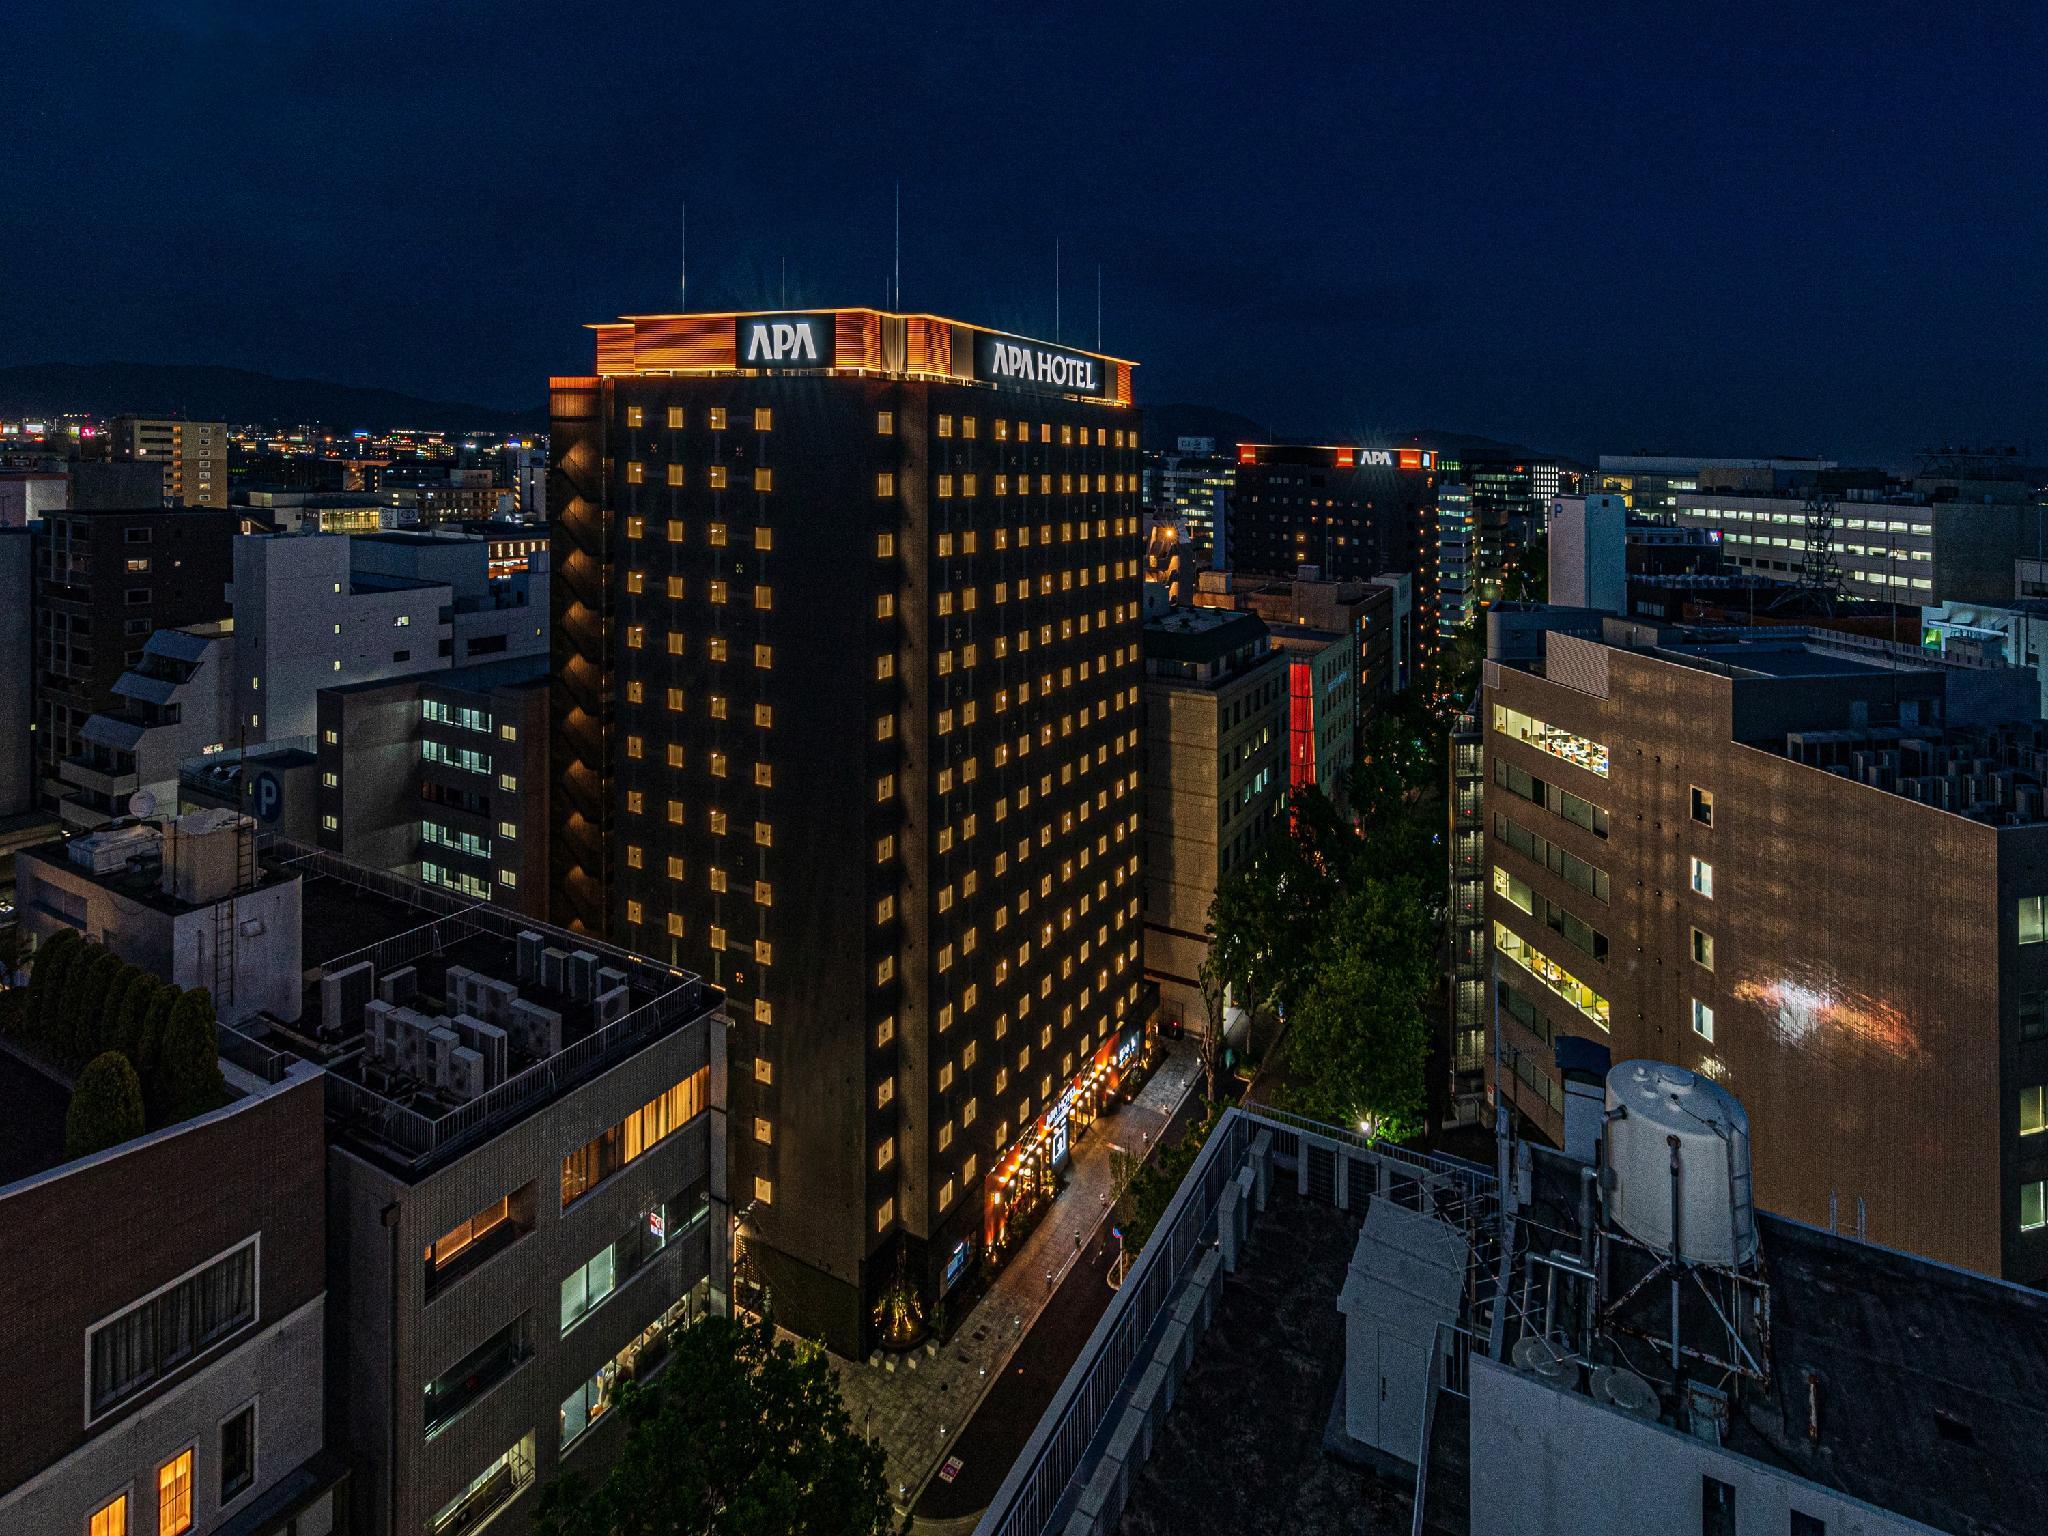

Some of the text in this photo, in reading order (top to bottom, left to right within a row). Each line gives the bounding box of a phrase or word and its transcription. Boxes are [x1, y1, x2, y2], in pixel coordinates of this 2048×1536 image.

[748, 324, 816, 360] APA
[992, 343, 1096, 389] APA HOTEL
[1361, 451, 1392, 465] APA
[1555, 503, 1563, 518] P
[261, 779, 277, 816] P
